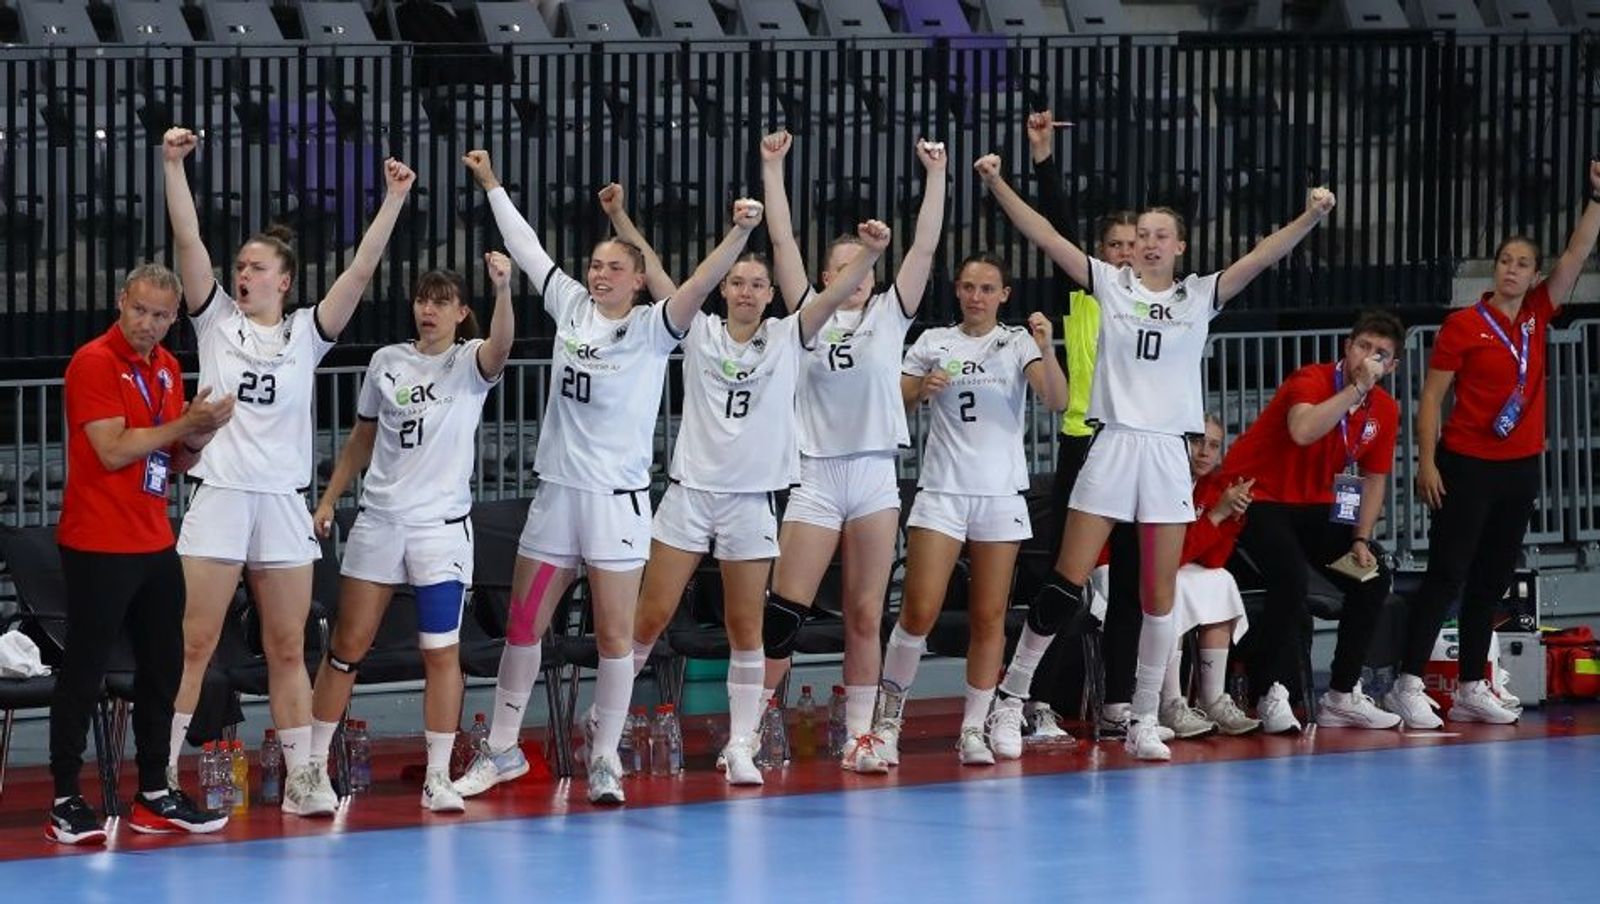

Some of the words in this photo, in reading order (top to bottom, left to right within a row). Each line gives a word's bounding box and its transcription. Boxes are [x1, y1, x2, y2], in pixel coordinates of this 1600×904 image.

[829, 344, 854, 371] 15
[1136, 329, 1161, 360] 10
[238, 371, 276, 405] 23
[561, 366, 591, 403] 20
[725, 390, 752, 418] 13
[958, 391, 977, 422] 2
[399, 418, 424, 448] 21
